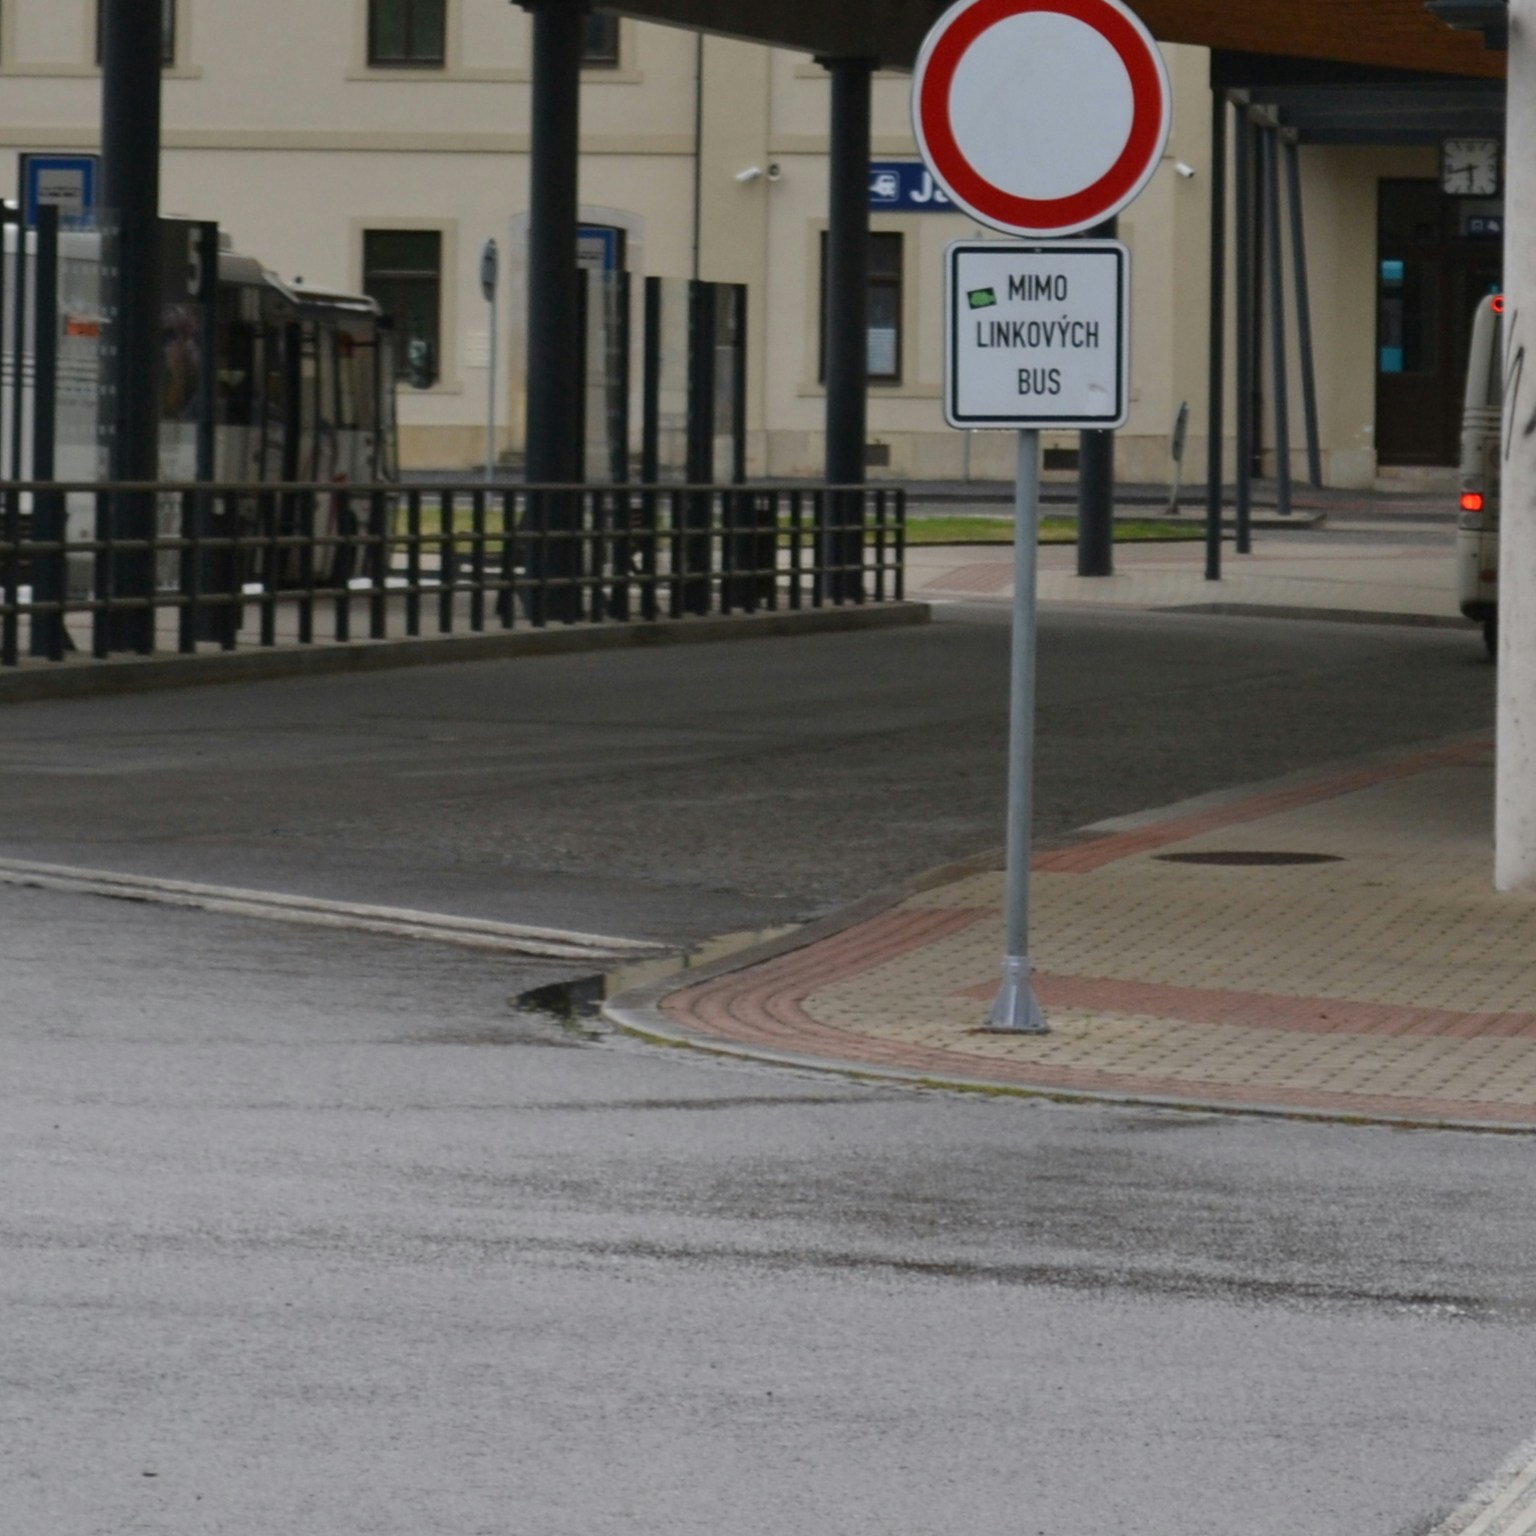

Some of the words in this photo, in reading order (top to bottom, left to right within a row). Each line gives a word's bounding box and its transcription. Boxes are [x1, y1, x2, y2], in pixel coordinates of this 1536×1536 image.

[1008, 274, 1068, 302] MIMO
[976, 314, 1099, 349] LINKOVÝCH
[1018, 368, 1062, 396] BUS
